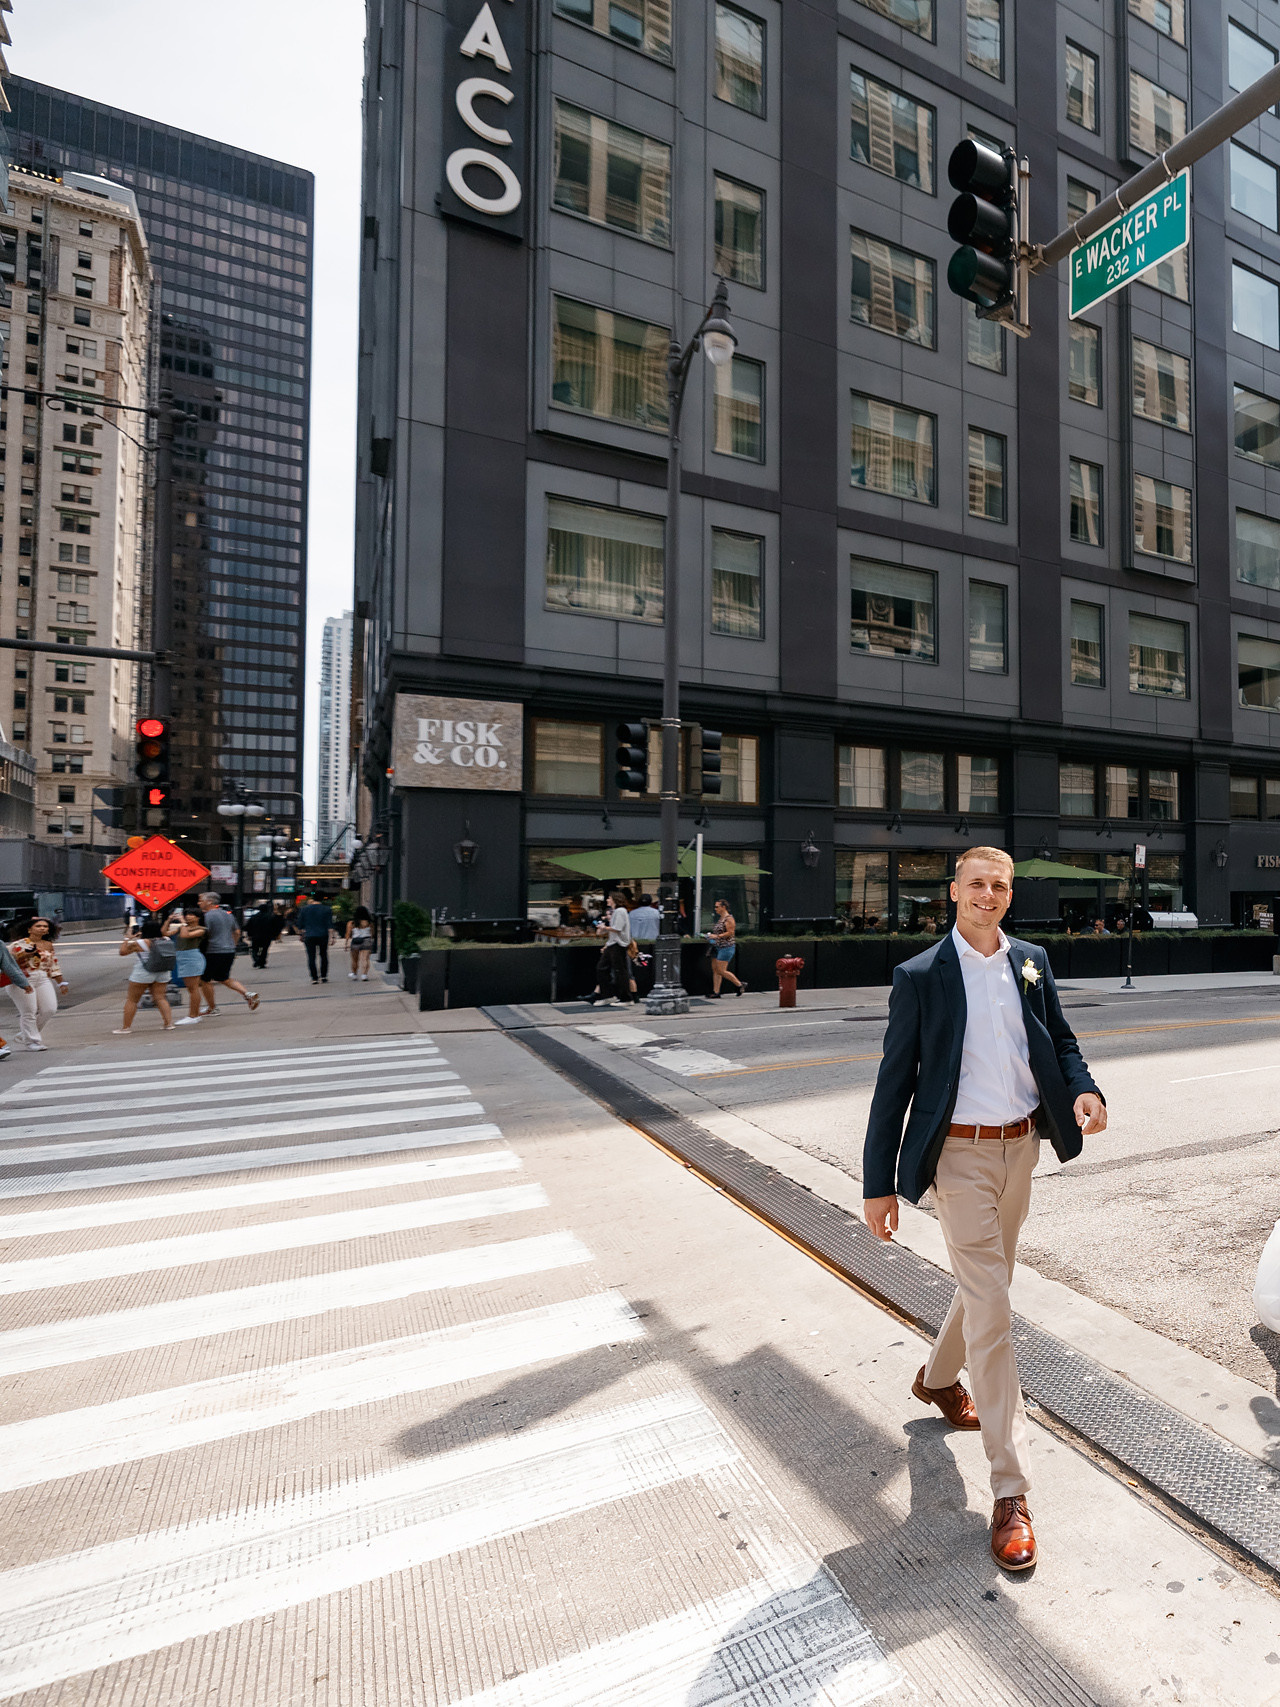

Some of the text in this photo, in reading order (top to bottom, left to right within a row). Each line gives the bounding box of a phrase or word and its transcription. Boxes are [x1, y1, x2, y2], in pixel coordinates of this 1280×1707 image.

[446, 0, 522, 215] ACO
[1075, 191, 1182, 279] E WACKER PL
[1106, 243, 1145, 285] 232 N
[416, 717, 503, 747] FISK
[412, 742, 508, 769] & CO.
[141, 851, 173, 861] ROAD
[113, 867, 198, 878] CONSTRUCTION
